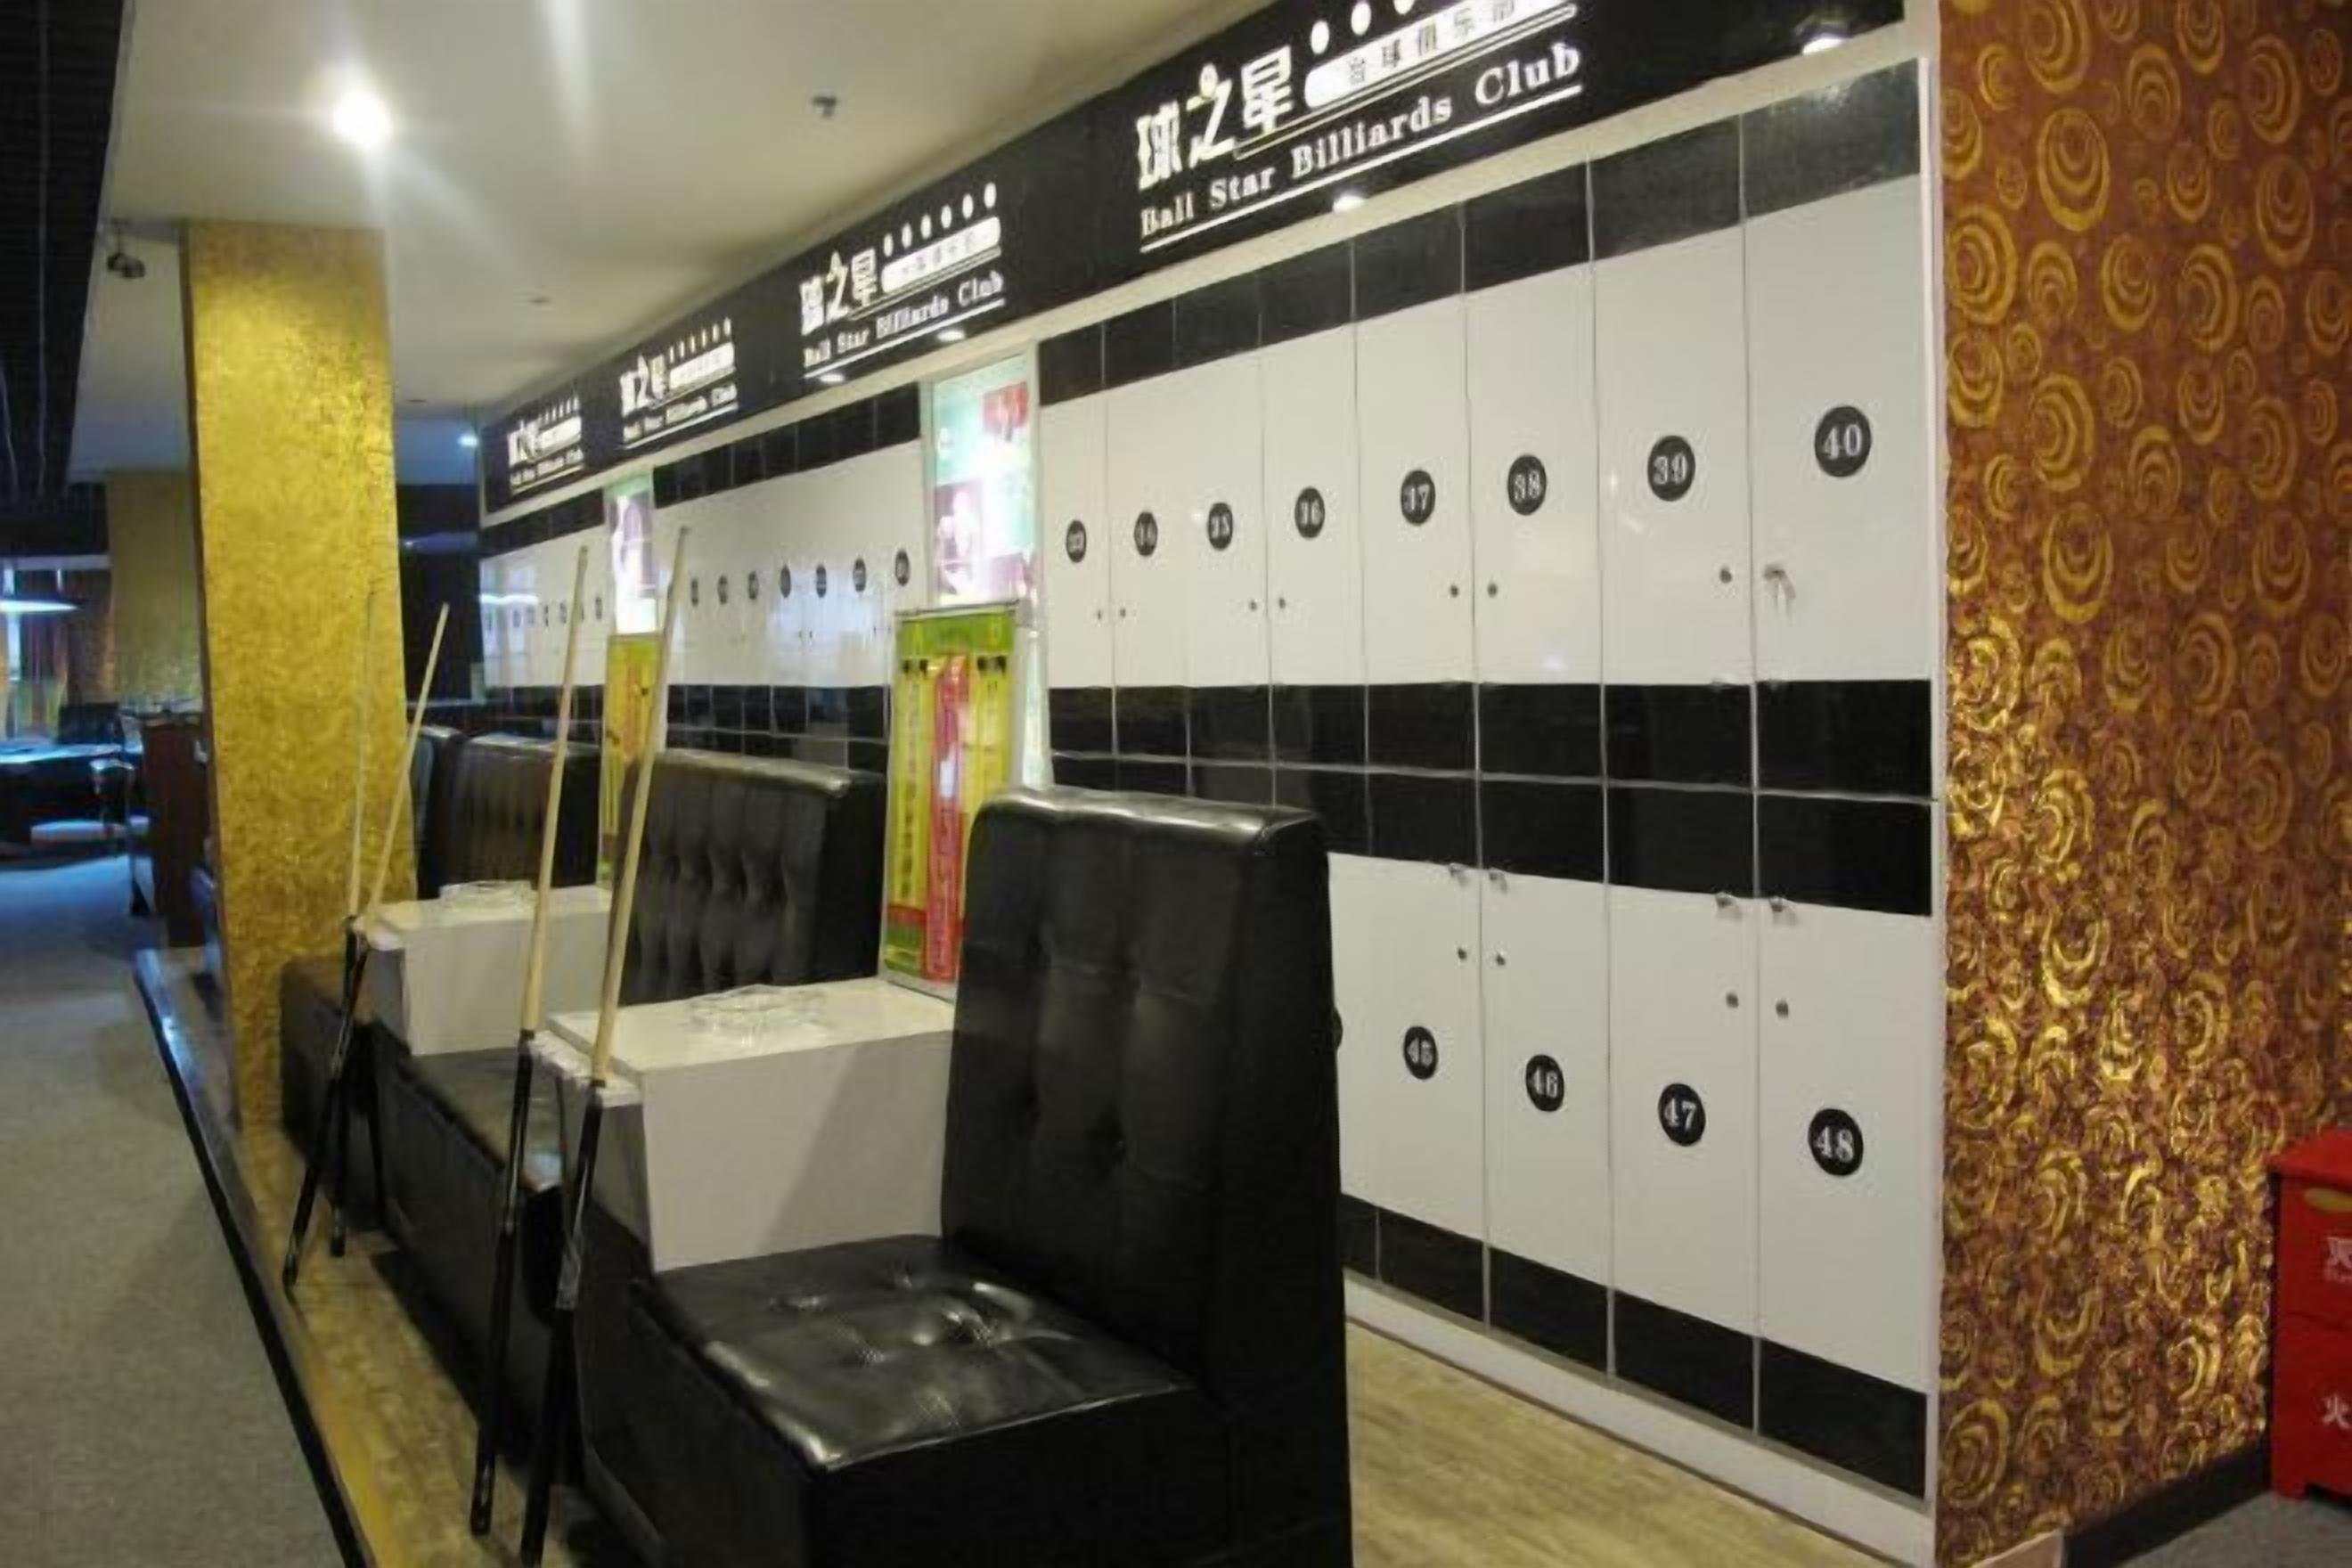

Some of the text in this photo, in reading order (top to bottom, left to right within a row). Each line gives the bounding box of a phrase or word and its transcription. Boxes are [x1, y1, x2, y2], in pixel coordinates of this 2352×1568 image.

[1141, 42, 1581, 238] Ball Star Billiards Club
[1824, 423, 1864, 461] 40
[1663, 1097, 1697, 1131] 47
[1815, 1125, 1855, 1164] 48
